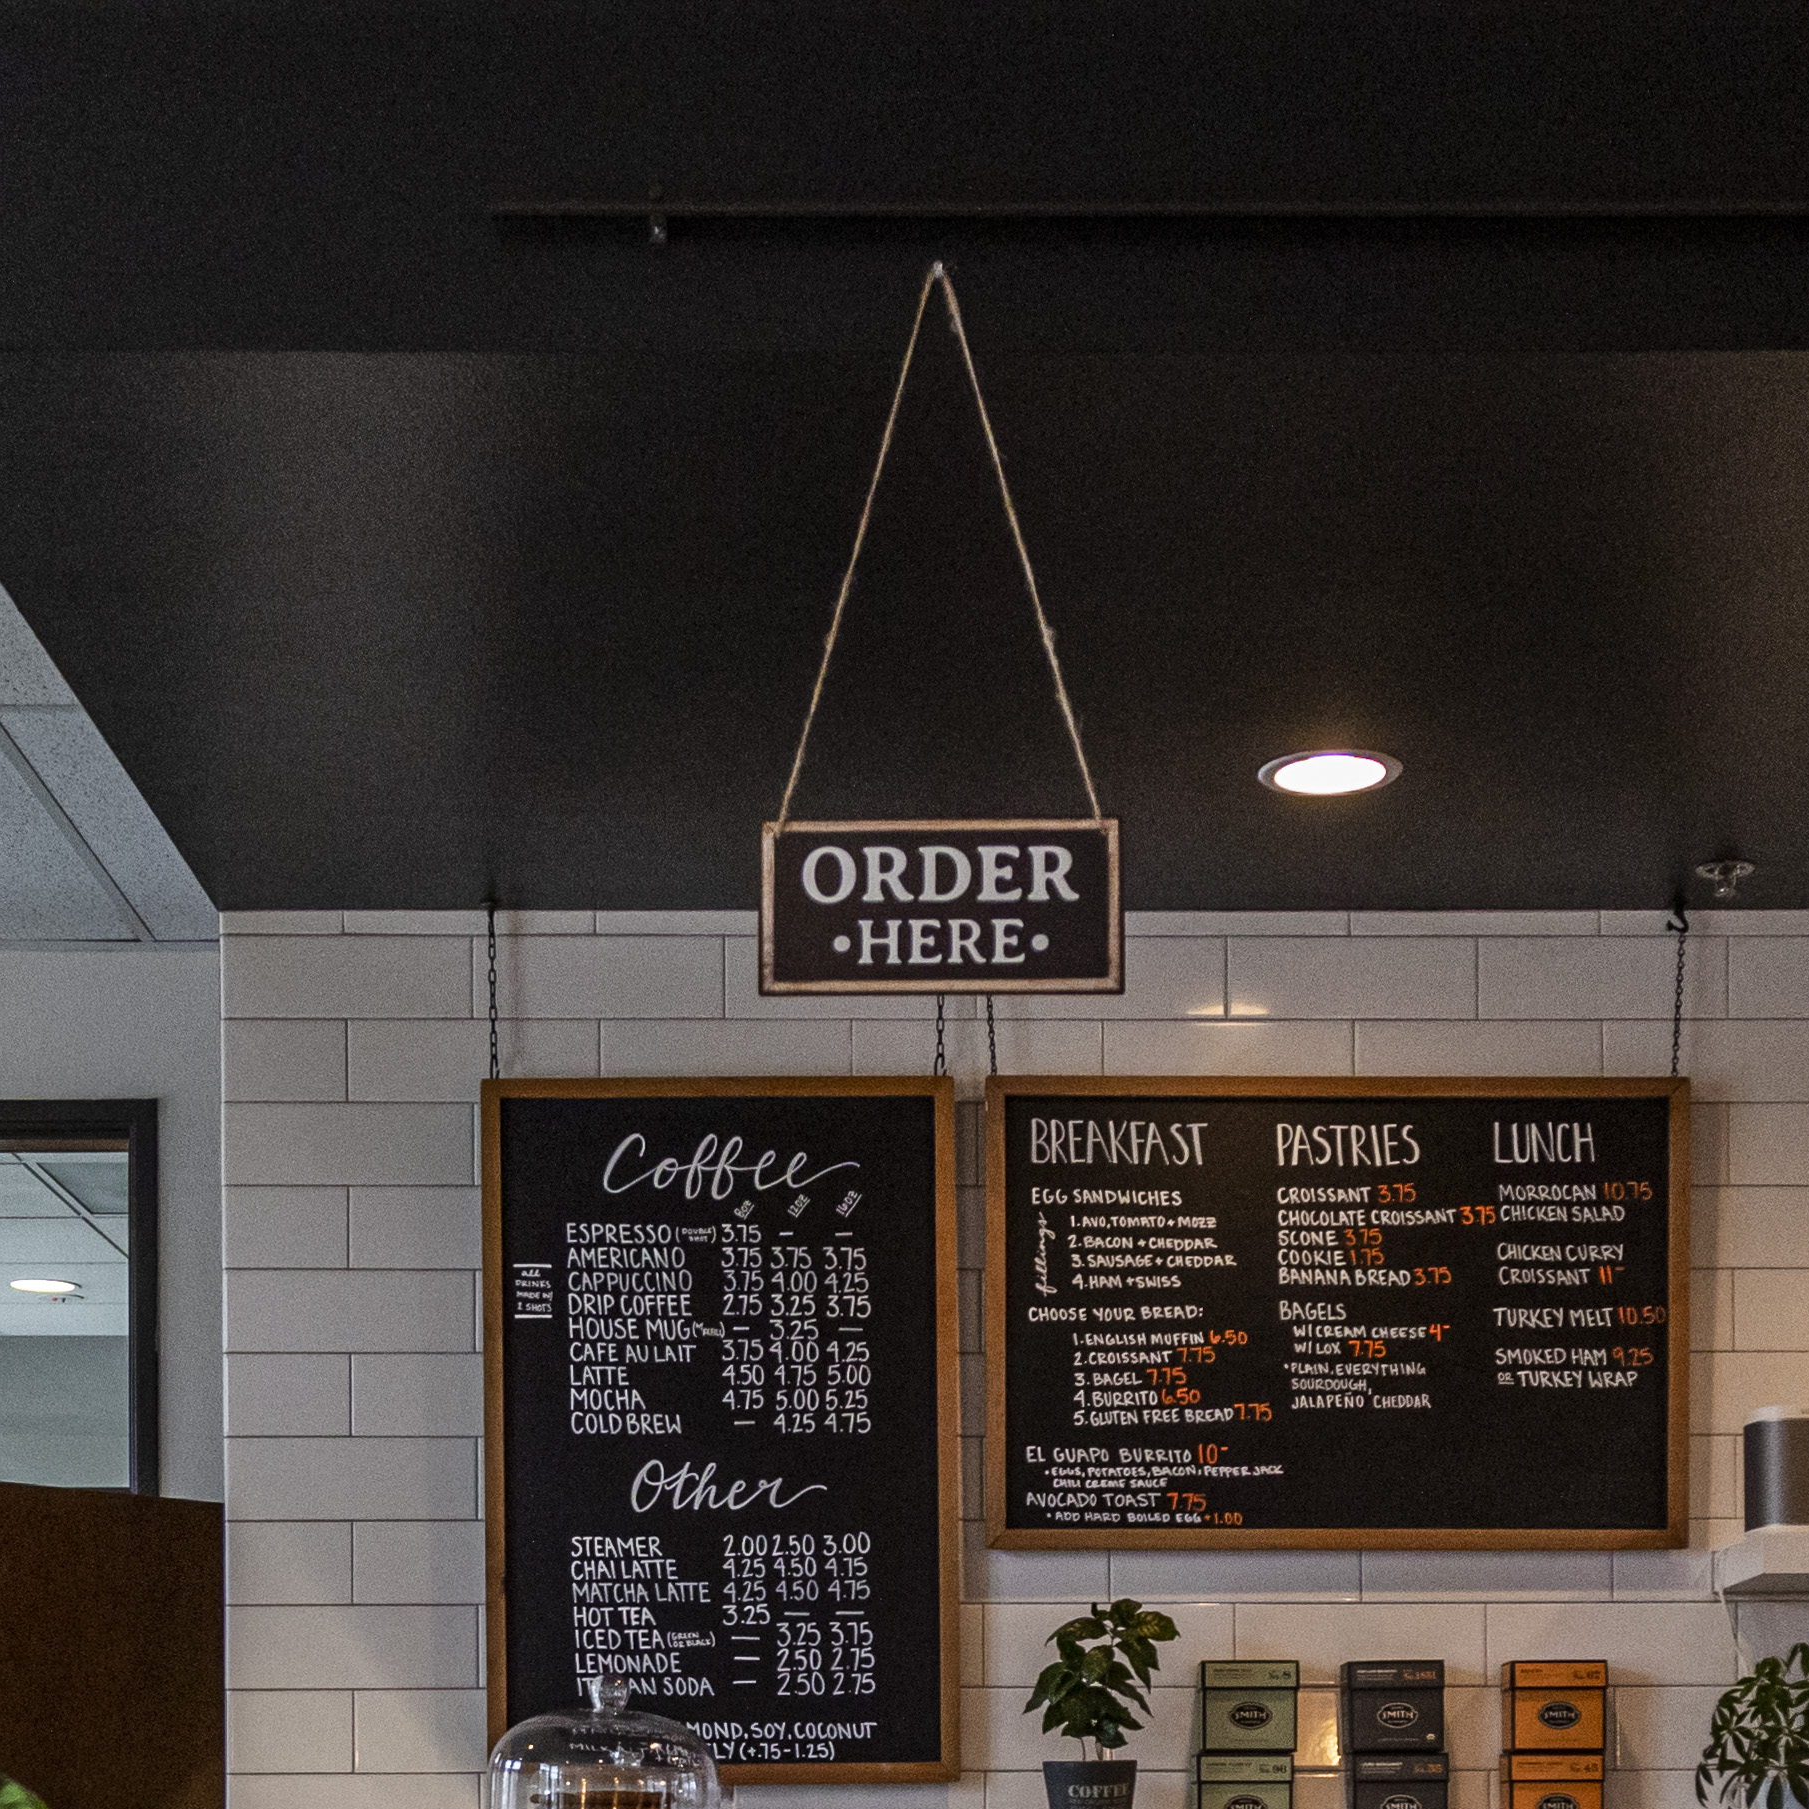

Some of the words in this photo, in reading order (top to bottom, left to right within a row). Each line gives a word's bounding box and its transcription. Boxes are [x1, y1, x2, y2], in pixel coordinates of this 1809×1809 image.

[801, 845, 1079, 904] ORDER
[1031, 1118, 1208, 1165] BREAKFAST
[1276, 1123, 1420, 1167] PASTRIES
[1494, 1122, 1594, 1163] LUNCH
[603, 1133, 859, 1200] Coffee
[1032, 1187, 1068, 1204] EGG
[1073, 1189, 1182, 1206] SANDWICHES
[1277, 1187, 1371, 1204] CROISSANT
[1378, 1183, 1416, 1203] 3.75
[1499, 1185, 1596, 1201] MORROCAN
[1605, 1182, 1652, 1199] 10.75
[1277, 1209, 1365, 1226] CHOCOLATE
[1370, 1209, 1456, 1226] CROISSANT
[1460, 1205, 1496, 1225] 3.75
[1500, 1205, 1567, 1221] CHICKEN
[1572, 1205, 1625, 1222] SALAD
[567, 1223, 671, 1244] ESPRESSO
[722, 1224, 761, 1243] 3.75
[1278, 1229, 1338, 1246] SCONE
[1344, 1228, 1382, 1246] 3.75
[567, 1247, 685, 1268] AMERICANO
[722, 1247, 762, 1267] 3.75
[771, 1247, 811, 1268] 3.75
[823, 1247, 866, 1270] 3.75
[1034, 1212, 1057, 1296] fillings
[1278, 1249, 1346, 1266] COOKIE
[1350, 1247, 1384, 1265] 1.75
[1497, 1243, 1561, 1261] CHICKEN
[1566, 1244, 1623, 1261] CURRY
[568, 1270, 692, 1292] CAPPUCCINO
[724, 1270, 763, 1292] 3.75
[772, 1271, 817, 1293] 4.00
[825, 1272, 868, 1293] 4.25
[1277, 1266, 1351, 1285] BANANA
[1355, 1269, 1411, 1286] BREAD
[1414, 1267, 1451, 1286] 3.75
[1499, 1266, 1590, 1285] CROISSANT
[568, 1293, 615, 1315] DRIP
[620, 1294, 691, 1316] COFFEE
[723, 1293, 762, 1315] 2.75
[771, 1294, 815, 1316] 3.25
[827, 1295, 871, 1318] 3.75
[1028, 1307, 1086, 1322] CHOOSE
[1093, 1307, 1135, 1321] YOUR
[1140, 1305, 1203, 1320] BREAD:
[1279, 1300, 1346, 1320] BAGELS
[1493, 1307, 1563, 1328] TURKEY
[1570, 1308, 1613, 1326] MELT
[1619, 1306, 1666, 1324] 10.50
[569, 1317, 639, 1339] HOUSE
[646, 1319, 690, 1340] MUG
[770, 1319, 818, 1340] 3.25
[1085, 1333, 1146, 1346] ENGLISH
[1150, 1332, 1204, 1346] MUFFIN
[1209, 1329, 1248, 1345] 6.50
[570, 1342, 618, 1362] CAFE
[626, 1344, 648, 1363] AU
[654, 1345, 696, 1362] LAIT
[722, 1339, 763, 1361] 3.75
[770, 1337, 819, 1363] 4.00
[827, 1341, 869, 1362] 4.25
[1088, 1350, 1172, 1365] CROISSANT
[1177, 1346, 1215, 1363] 7.75
[1496, 1348, 1566, 1365] SMOKED
[1571, 1349, 1606, 1365] HAM
[1613, 1347, 1652, 1366] 9.25
[570, 1365, 629, 1386] LATTE
[722, 1364, 764, 1385] 4.50
[775, 1364, 816, 1386] 4.75
[828, 1364, 871, 1386] 5.00
[1093, 1372, 1142, 1386] BAGEL
[1146, 1366, 1186, 1385] 7.75
[1517, 1370, 1582, 1388] TURKEY
[1588, 1371, 1637, 1387] WRAP
[570, 1388, 646, 1411] MOCHA
[723, 1389, 764, 1409] 4.75
[776, 1389, 819, 1411] 5.00
[826, 1389, 867, 1410] 5.25
[1092, 1390, 1158, 1407] BURRITO
[1161, 1387, 1200, 1405] 6.50
[571, 1411, 622, 1434] COLD
[626, 1413, 681, 1434] BREW
[774, 1413, 815, 1433] 4.25
[825, 1412, 871, 1433] 4.75
[1090, 1410, 1138, 1426] GLUTEN
[1143, 1408, 1179, 1423] FREE
[1184, 1408, 1234, 1423] BREAD
[1234, 1403, 1272, 1421] 7.75
[1026, 1446, 1045, 1462] EL
[1053, 1447, 1109, 1463] GUAPO
[1119, 1448, 1191, 1463] BURRITO
[631, 1459, 827, 1512] Other
[1027, 1492, 1097, 1507] AVOCADO
[1103, 1493, 1160, 1507] TOAST
[1167, 1492, 1206, 1511] 7.75
[571, 1536, 662, 1557] STEAMER
[723, 1535, 767, 1557] 2.00
[772, 1534, 817, 1556] 2.50
[823, 1532, 870, 1556] 3.00
[571, 1560, 616, 1580] CHAI
[621, 1559, 678, 1580] LATTE
[572, 1583, 649, 1603] MATCHA
[655, 1582, 710, 1603] LATTE
[573, 1606, 614, 1627] HOT
[618, 1606, 656, 1626] TEA
[723, 1603, 770, 1626] 3.25
[575, 1652, 681, 1673] LEMONADE
[577, 1675, 656, 1696] ITAN
[664, 1677, 714, 1696] SODA
[1234, 1711, 1266, 1721] SMITH
[1382, 1710, 1414, 1719] SMITH
[1544, 1710, 1576, 1719] SMITH
[794, 1722, 877, 1739] COCONUT
